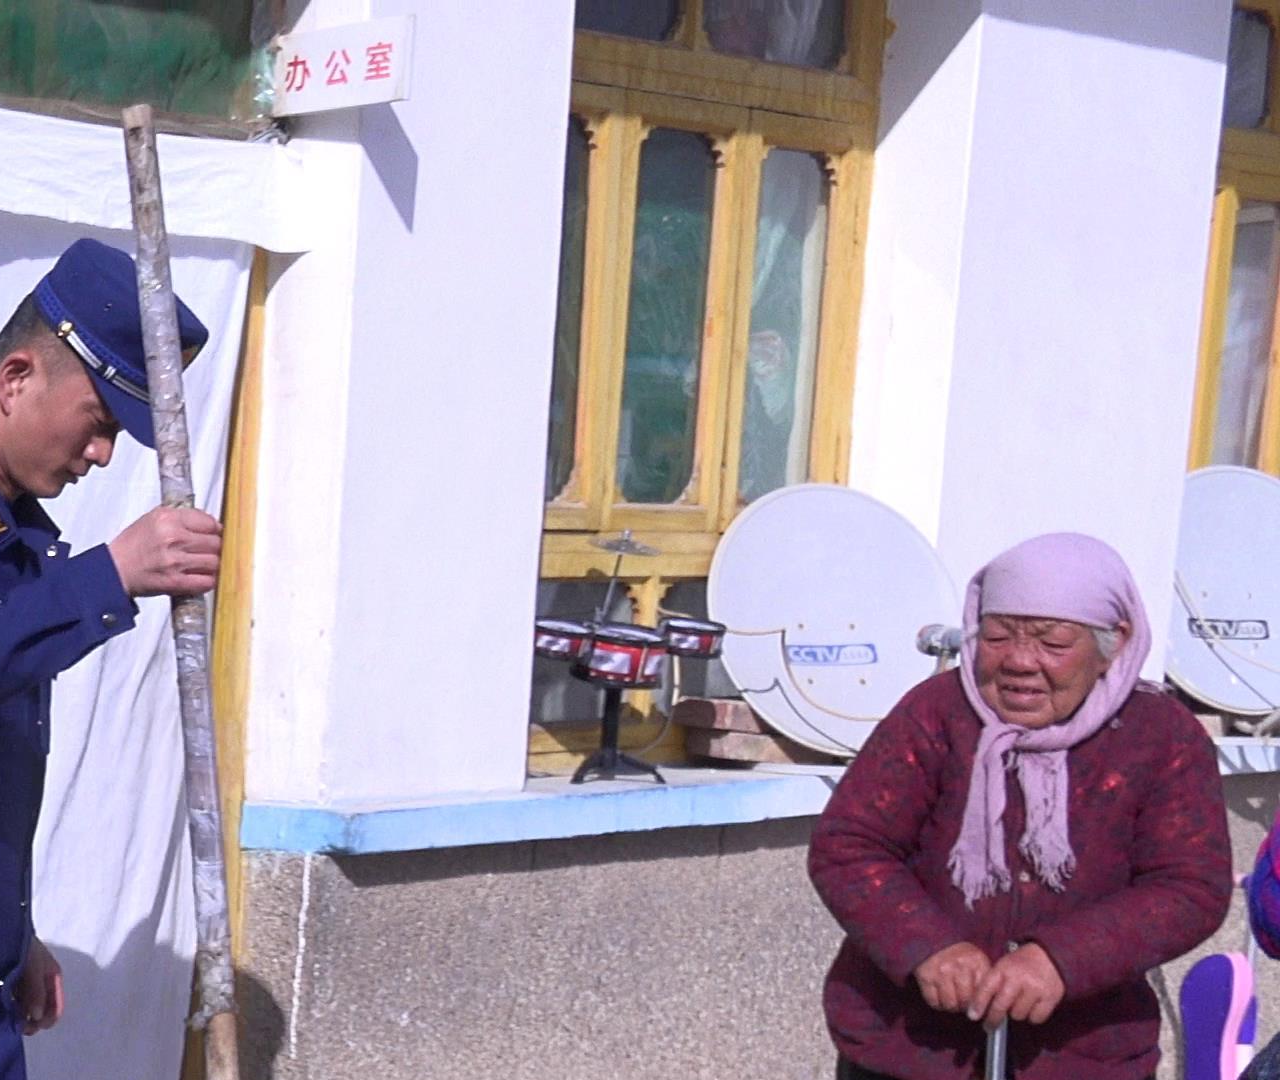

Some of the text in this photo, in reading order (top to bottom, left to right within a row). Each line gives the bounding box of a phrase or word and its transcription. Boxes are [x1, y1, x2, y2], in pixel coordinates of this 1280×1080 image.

[285, 42, 393, 92] 办公室
[787, 646, 839, 663] CCTV
